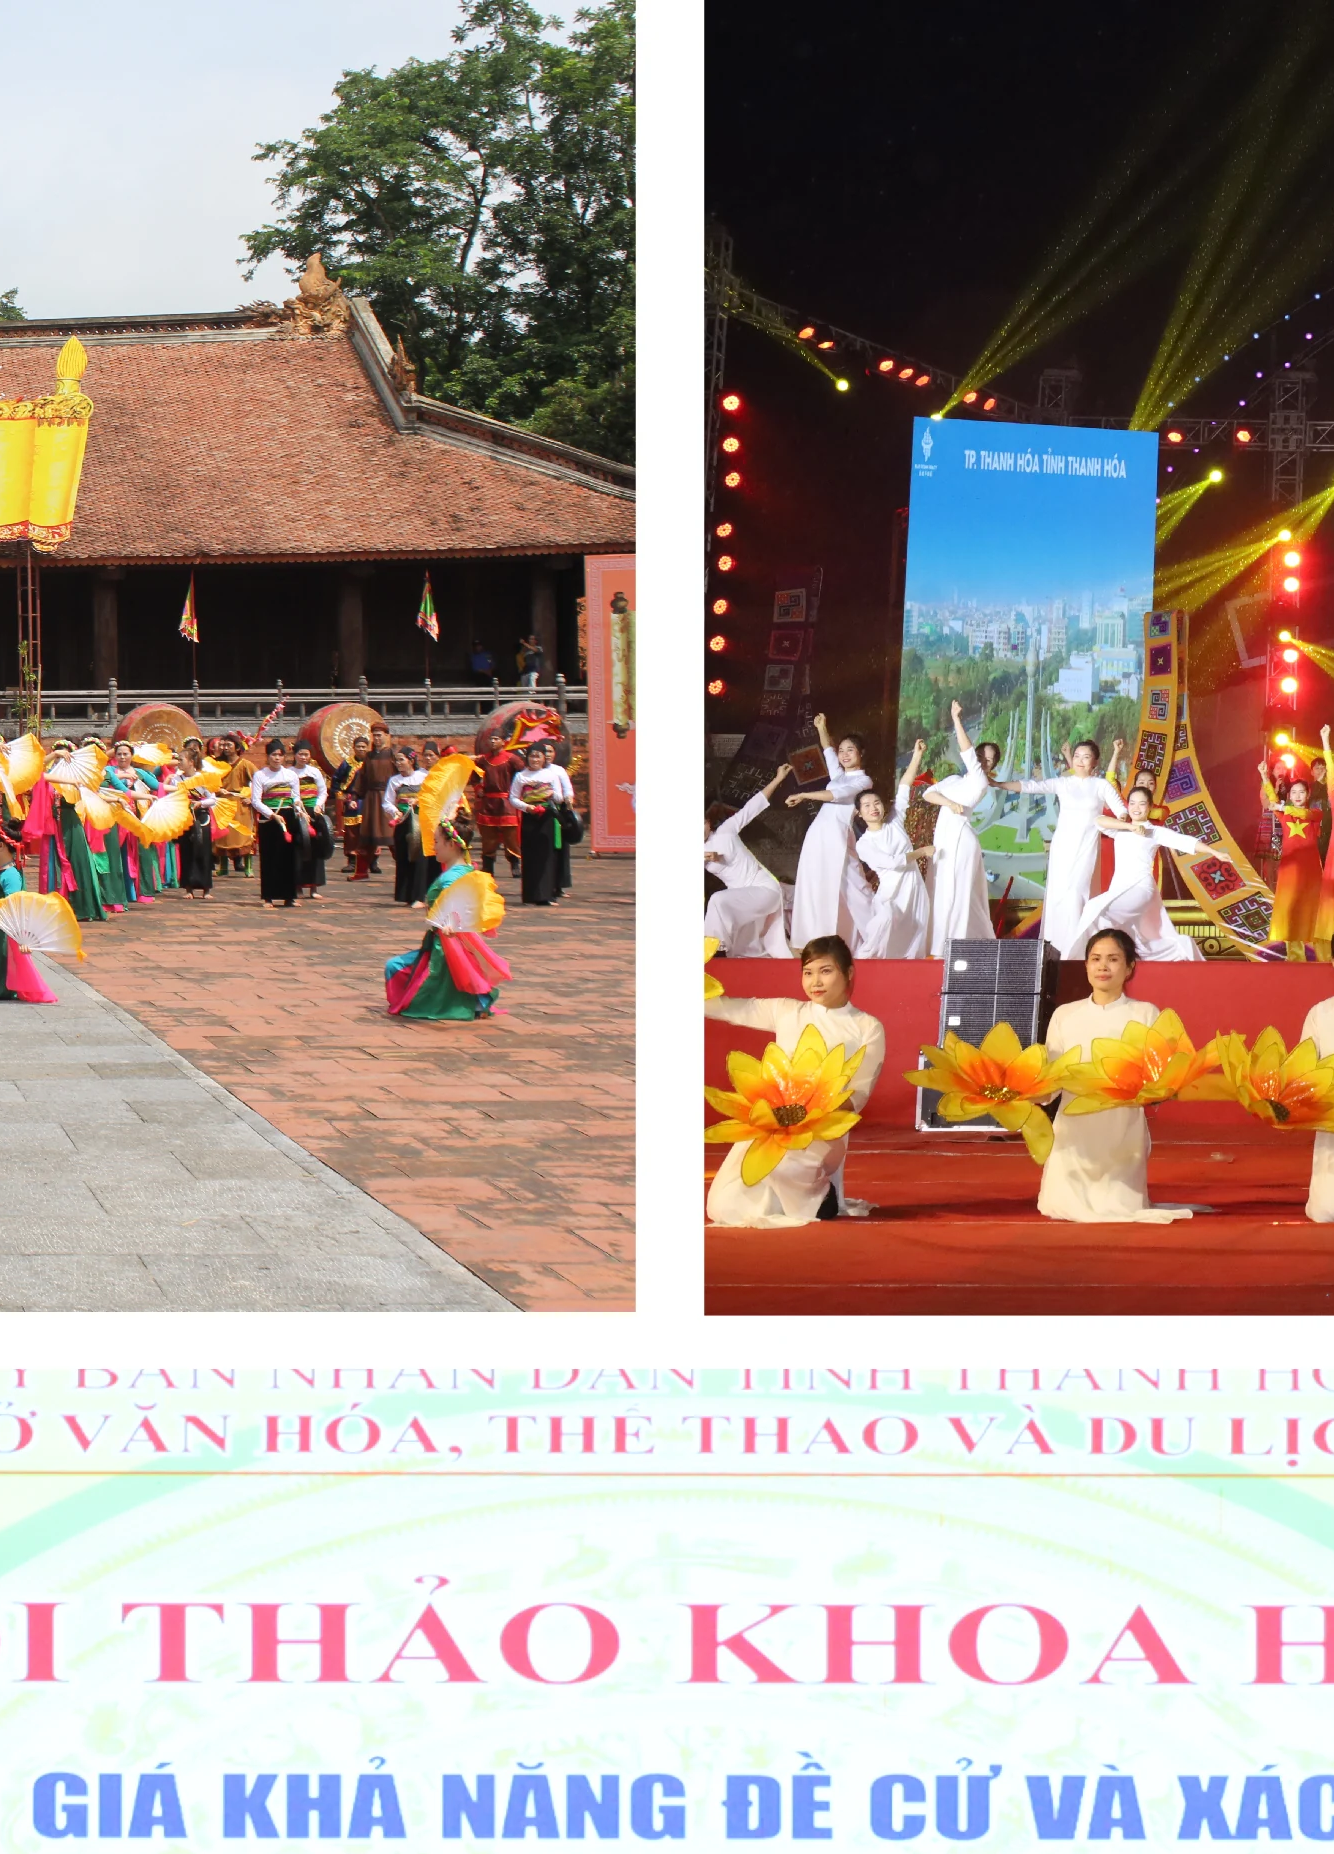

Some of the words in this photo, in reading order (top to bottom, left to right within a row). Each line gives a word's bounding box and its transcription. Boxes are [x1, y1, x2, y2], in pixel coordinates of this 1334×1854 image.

[964, 450, 976, 469] TP.
[980, 451, 1014, 471] THANH
[1017, 449, 1039, 473] HÓA
[1043, 448, 1065, 474] TỈNH
[1068, 456, 1100, 477] THANH
[1104, 453, 1126, 478] HÓA
[61, 1404, 231, 1454] VĂN
[264, 1402, 464, 1461] HÓA,
[681, 1416, 921, 1456] THAO
[946, 1404, 1056, 1456] VÀ
[1087, 1416, 1196, 1456] DU
[121, 1574, 620, 1686] THẢO
[676, 1603, 1197, 1686] KHOA
[32, 1762, 187, 1839] GIÁ
[223, 1756, 407, 1840] KHẢ
[442, 1762, 686, 1840] NĂNG
[722, 1751, 833, 1840] ĐỀ
[870, 1757, 1003, 1841] CỬ
[1025, 1764, 1146, 1841] VÀ
